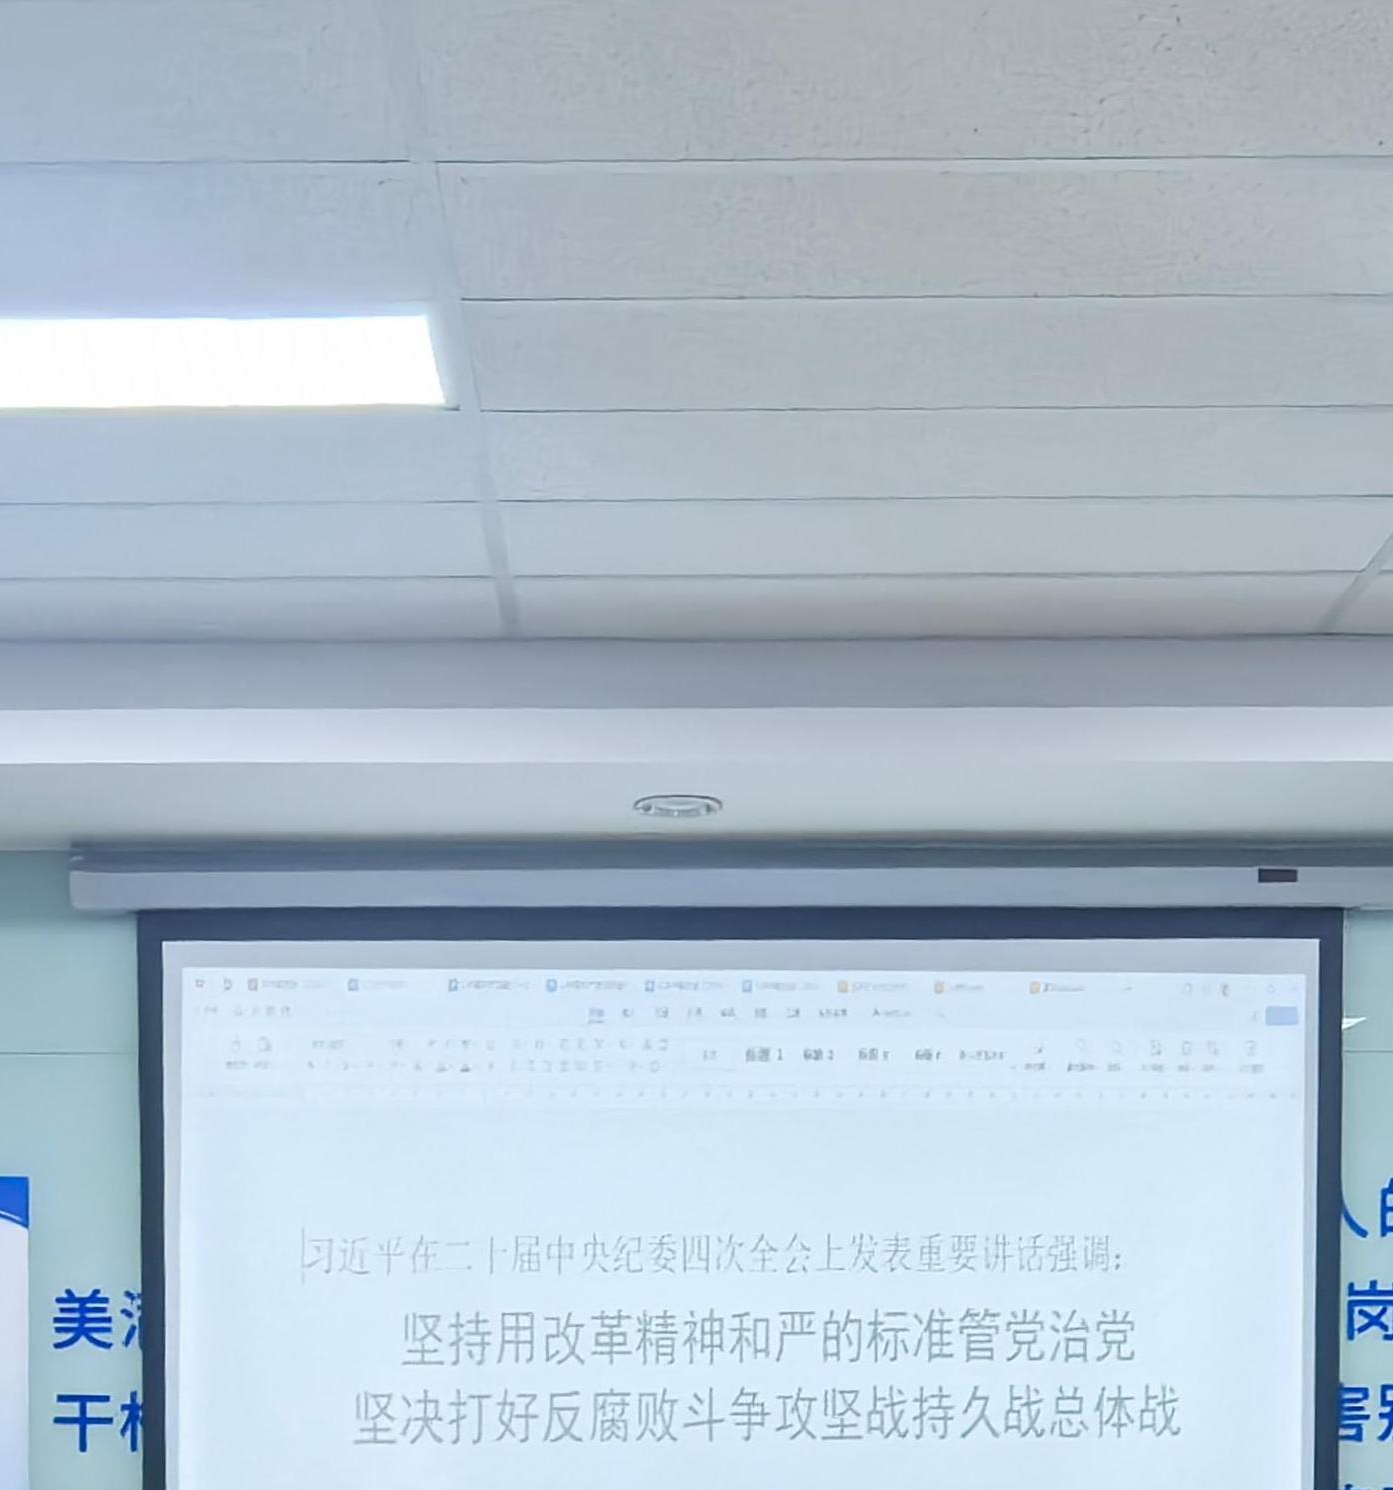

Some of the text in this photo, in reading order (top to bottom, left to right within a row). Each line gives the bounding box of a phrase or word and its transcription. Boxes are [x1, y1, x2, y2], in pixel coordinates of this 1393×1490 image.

[401, 1307, 1137, 1367] 坚持用改革精神和严的标准管党治党
[352, 1382, 1182, 1446] 坚决打好反腐败斗争攻坚战持久战总体战
